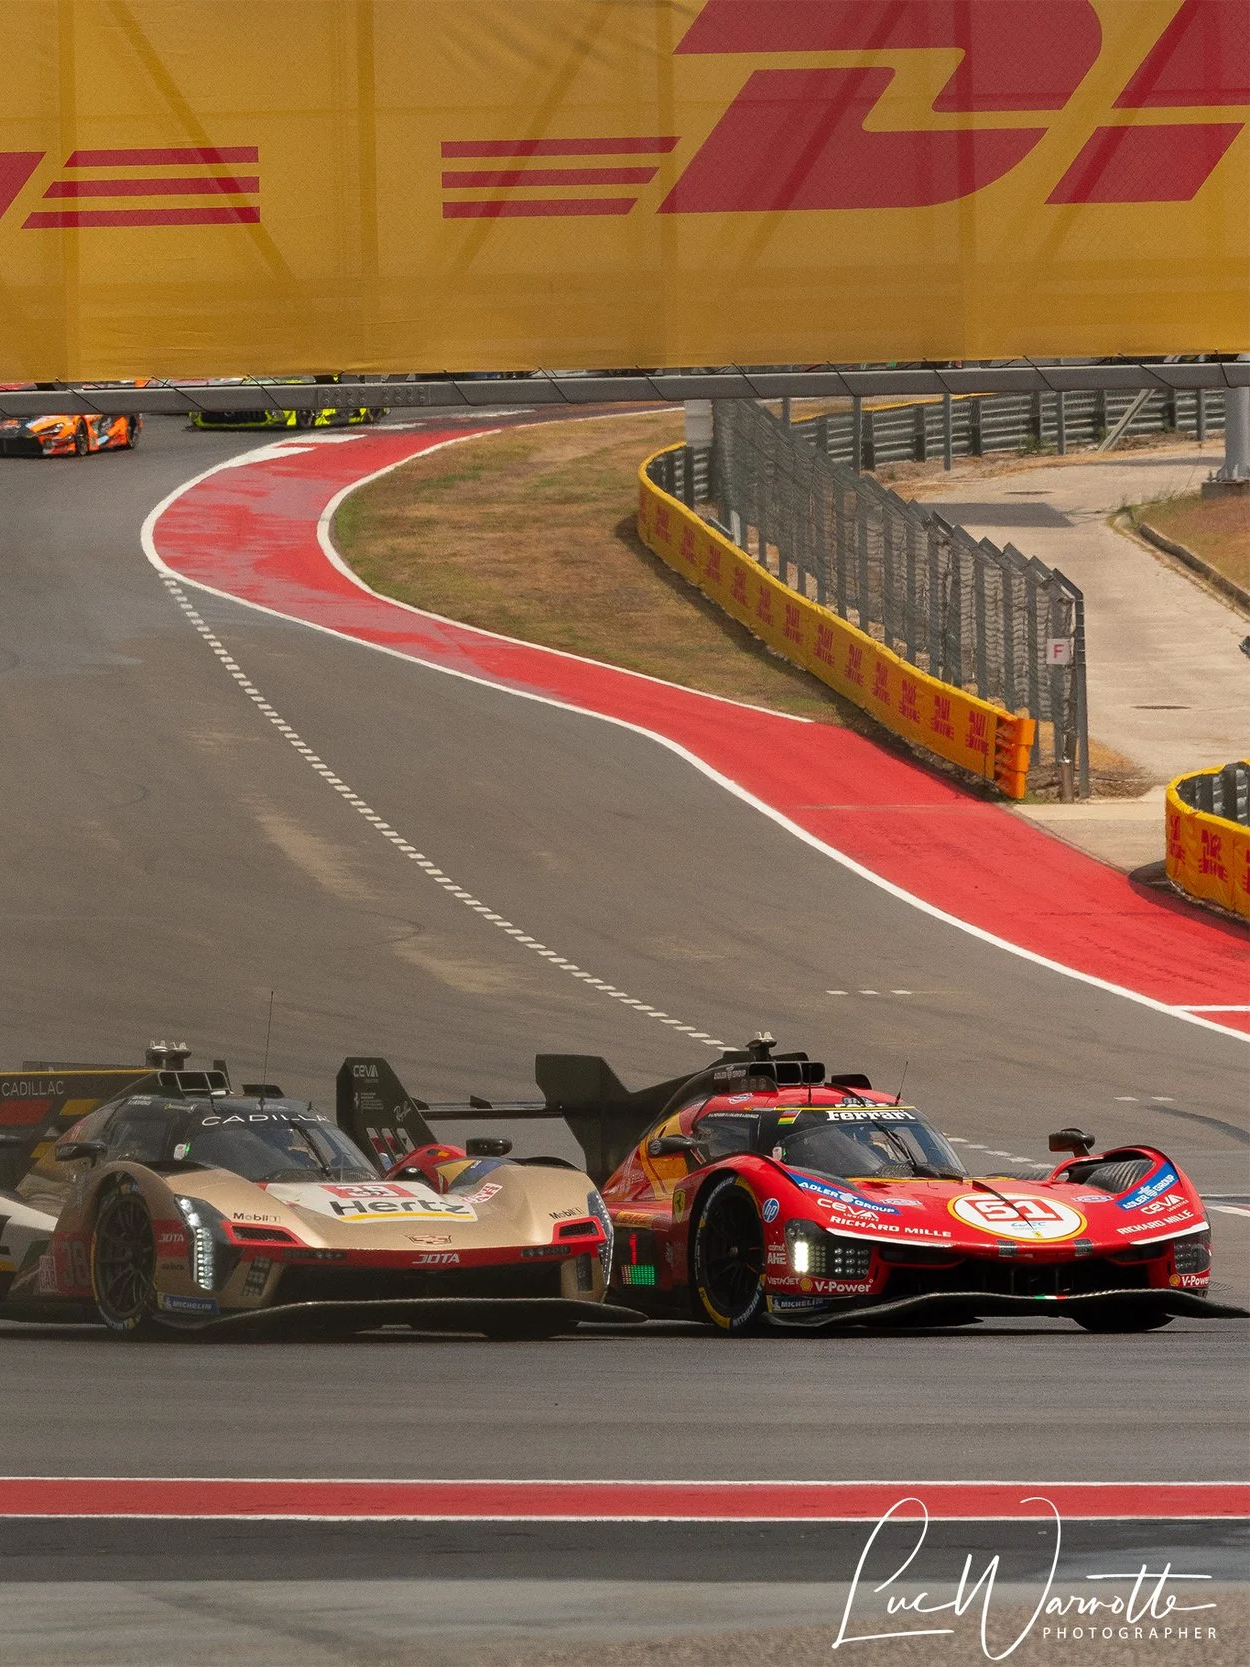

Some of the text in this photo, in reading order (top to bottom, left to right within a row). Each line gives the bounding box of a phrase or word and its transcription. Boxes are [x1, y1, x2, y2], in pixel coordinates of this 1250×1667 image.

[1053, 644, 1065, 659] F
[1, 1080, 65, 1097] CADILLAC
[826, 1109, 916, 1121] Ferrari
[798, 1181, 840, 1199] ADLER
[853, 1198, 896, 1214] GROUP
[1123, 1194, 1147, 1210] ADLER
[1155, 1174, 1176, 1192] GROUP
[329, 1198, 470, 1216] Hertz
[764, 1199, 778, 1223] hp
[975, 1200, 1058, 1219] 51
[233, 1212, 269, 1222] Mobil
[1116, 1209, 1195, 1235] RICHARD MILLE
[830, 1215, 952, 1238] RICHARD MILLE
[158, 1233, 185, 1243] JOTA
[412, 1253, 460, 1265] JOTA
[814, 1281, 872, 1293] V-Power
[172, 1300, 213, 1310] MICHELIN
[780, 1298, 824, 1309] MICHELIN
